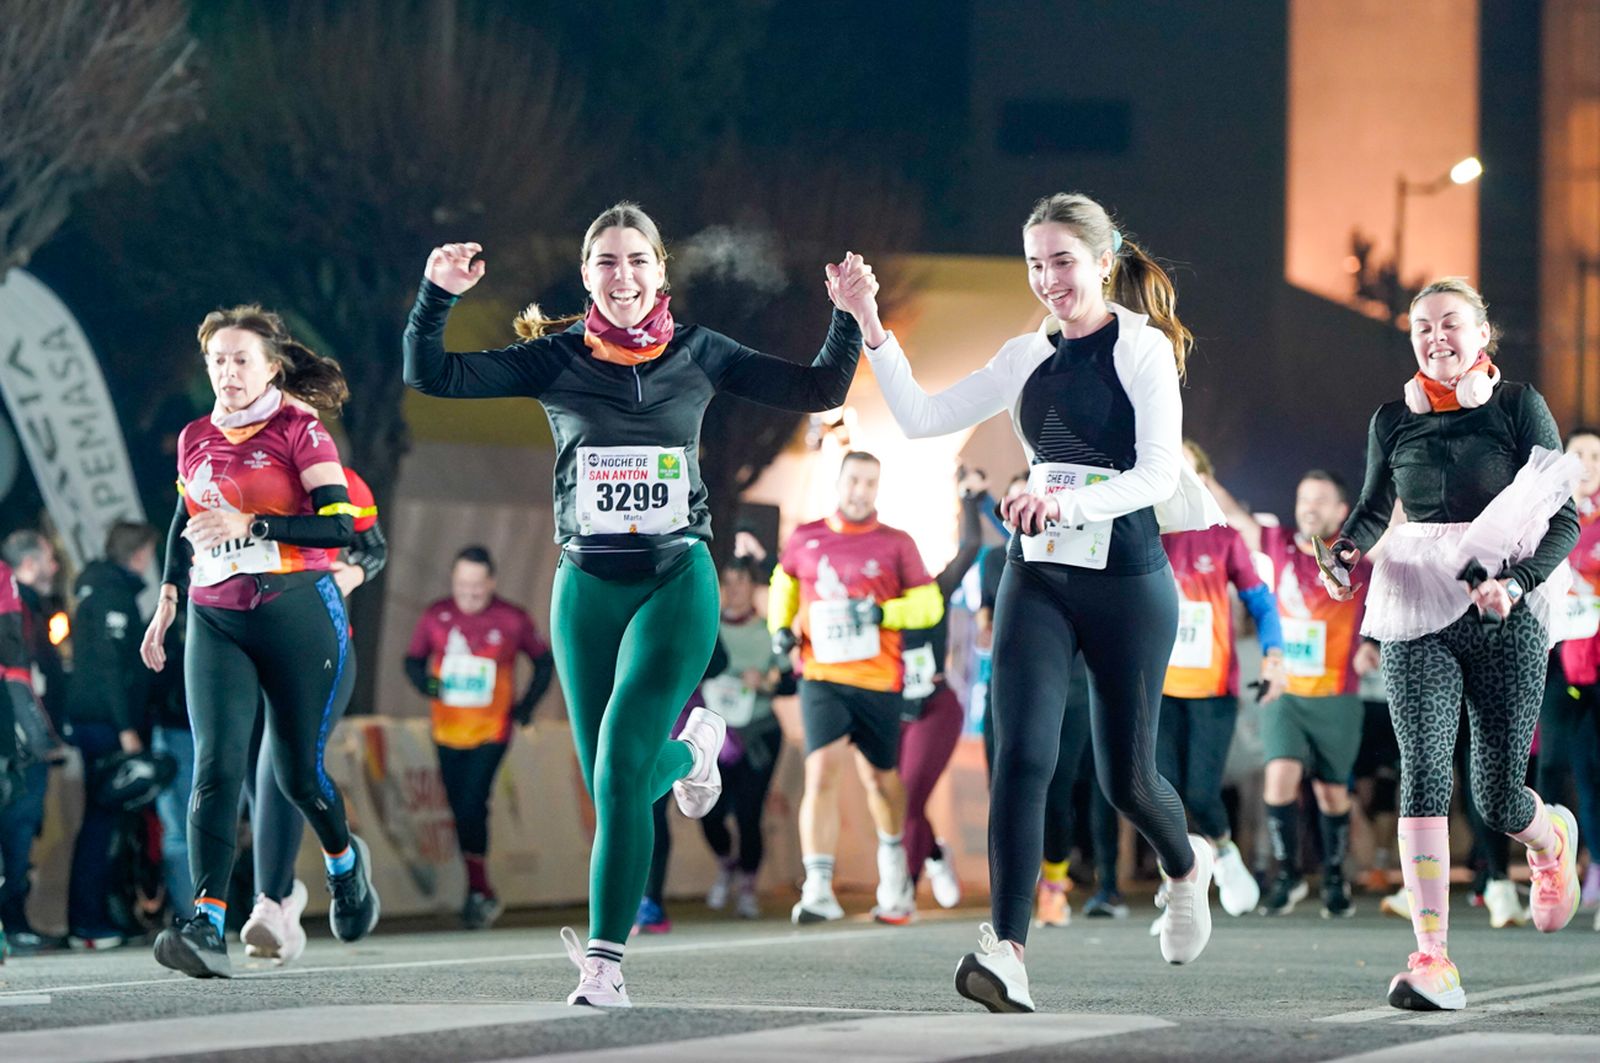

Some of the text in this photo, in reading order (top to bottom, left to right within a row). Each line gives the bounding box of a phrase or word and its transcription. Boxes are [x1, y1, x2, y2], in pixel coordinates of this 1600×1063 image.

[600, 458, 633, 468] NOCHE
[636, 457, 648, 467] DE
[589, 470, 610, 481] SAN
[612, 468, 648, 480] ANTÓN
[1063, 475, 1076, 485] DE
[596, 483, 669, 511] 3299
